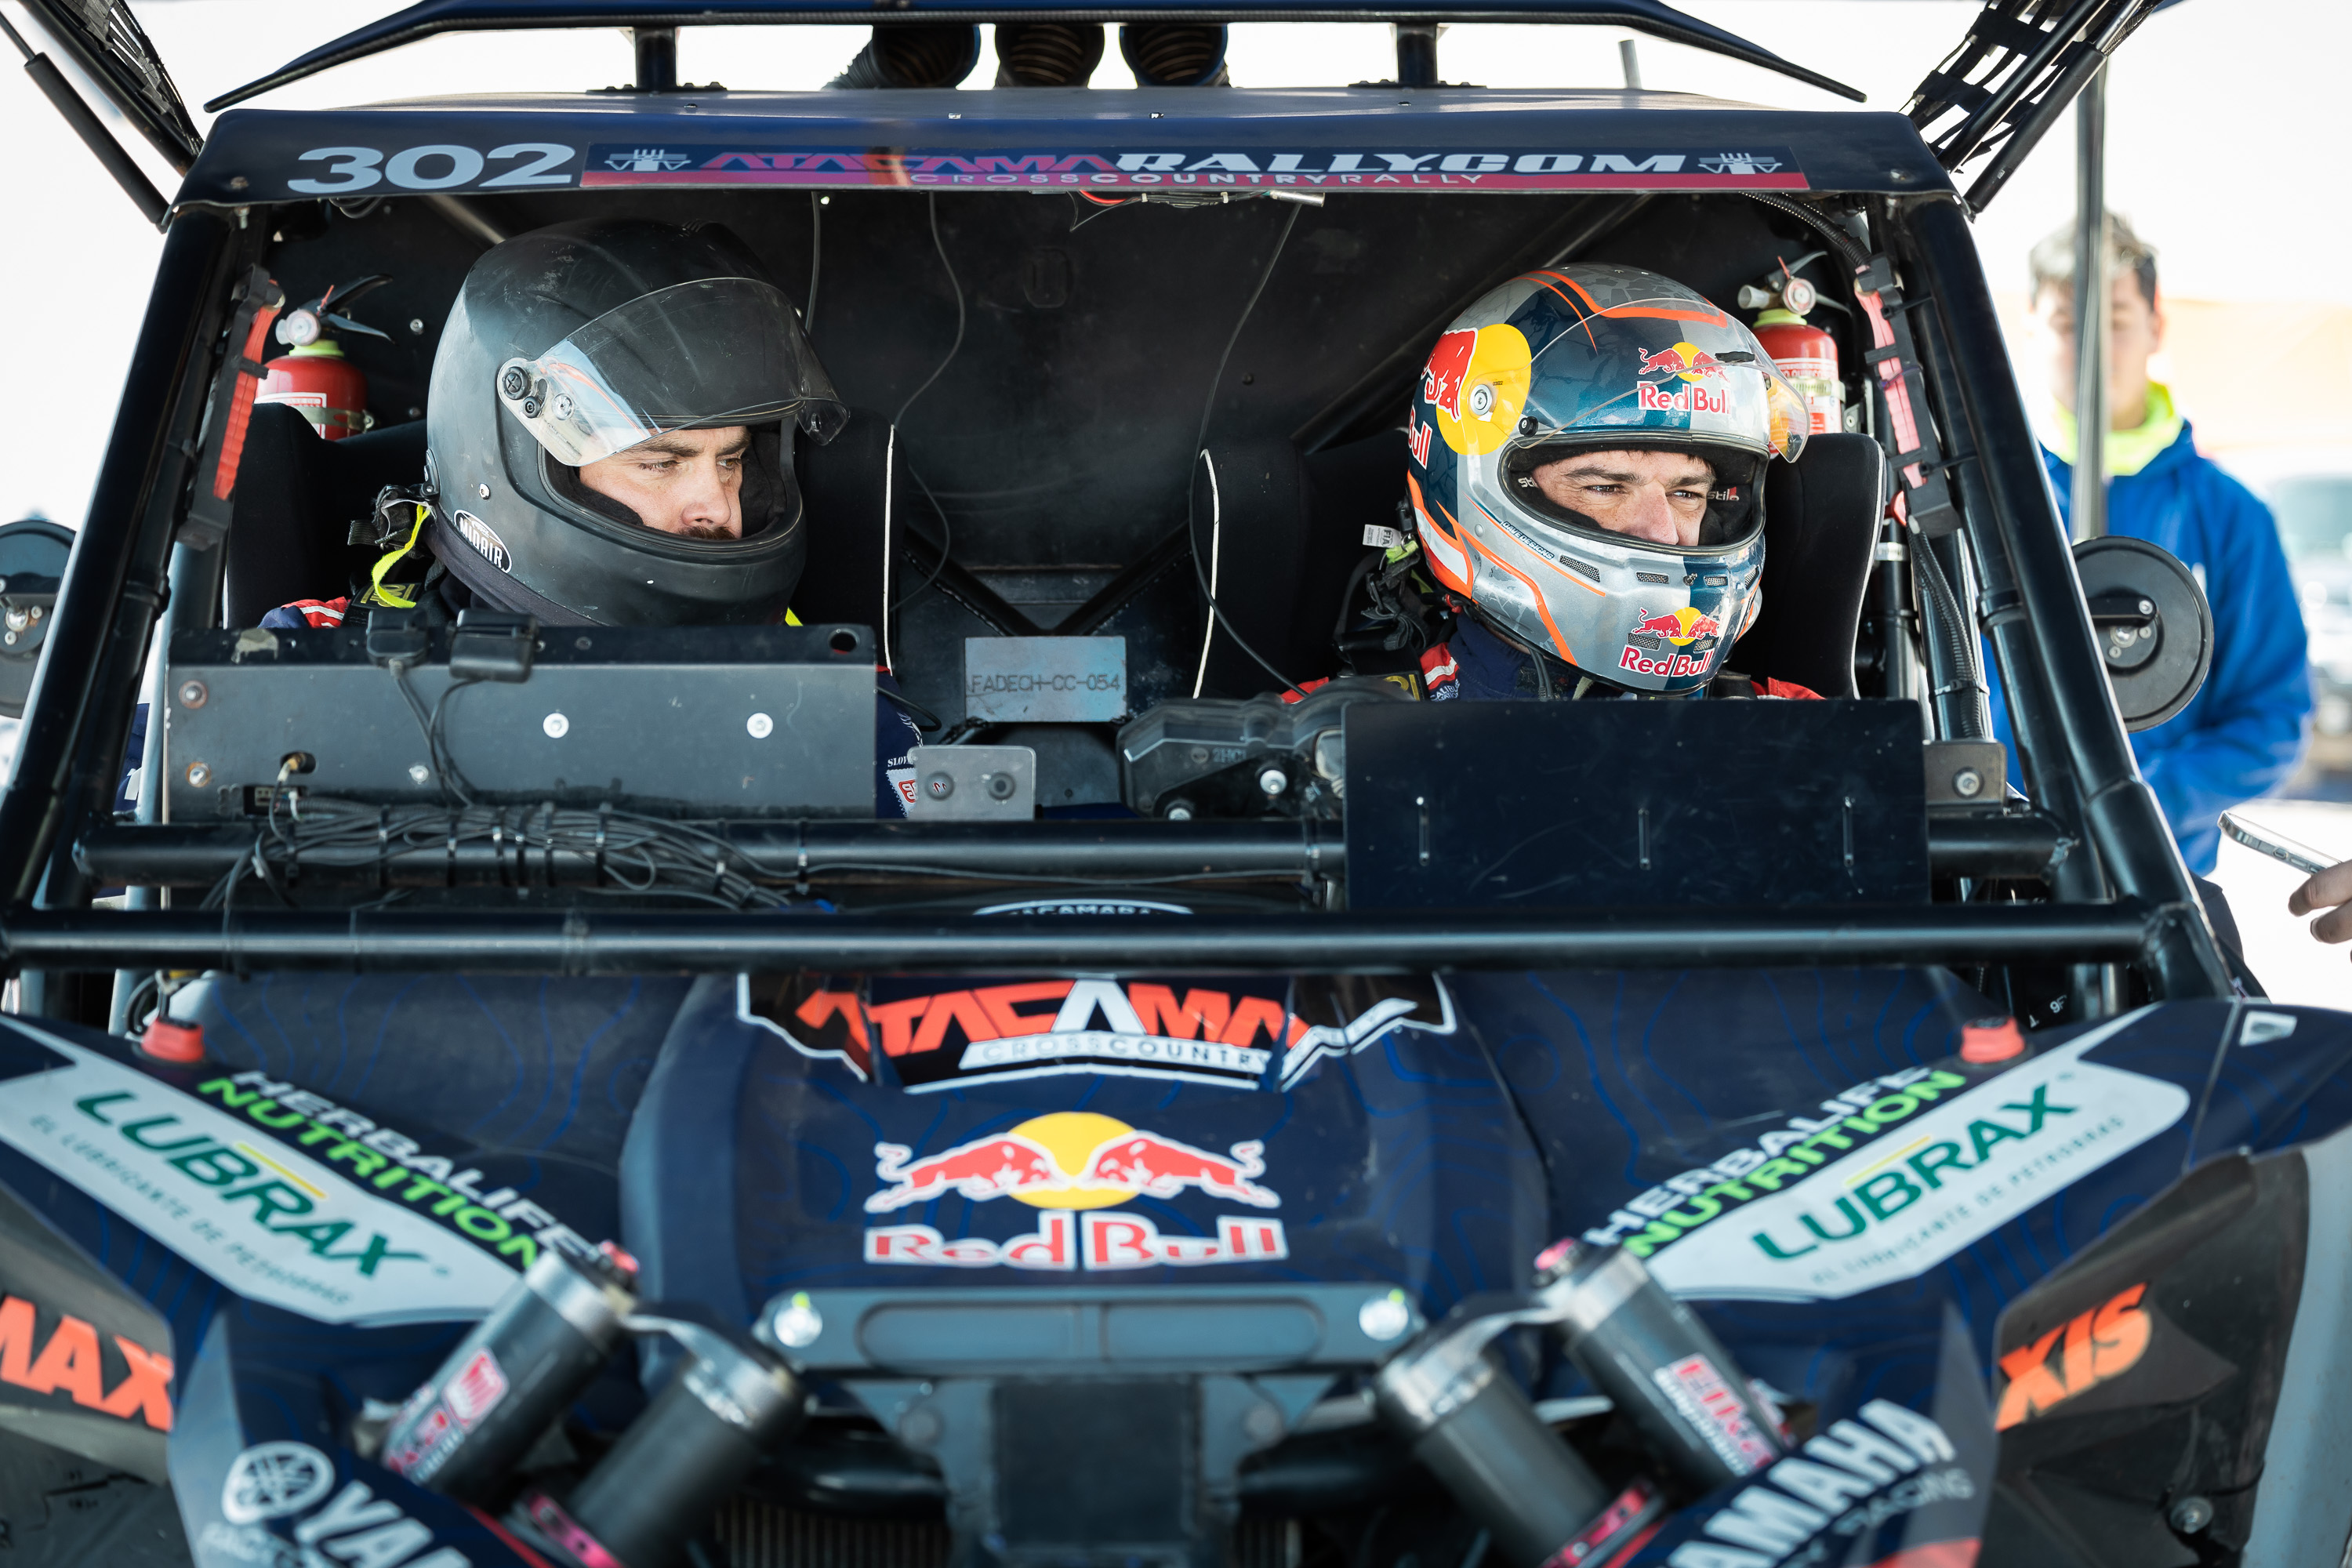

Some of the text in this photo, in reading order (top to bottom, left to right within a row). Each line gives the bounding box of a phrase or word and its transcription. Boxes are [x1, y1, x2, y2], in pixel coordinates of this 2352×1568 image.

[288, 143, 575, 194] 302
[1639, 381, 1731, 415] Red Bull
[459, 517, 503, 568] MIDAIR
[1382, 529, 1392, 545] FIA
[971, 674, 1120, 693] FADECH-CC-054
[1620, 646, 1715, 676] Red Bull
[795, 975, 1312, 1076] ATACAMA
[75, 1090, 430, 1278] LUBRAX
[198, 1078, 536, 1269] NUTRITION
[232, 1071, 605, 1260] HERBALIFE
[1581, 1066, 1932, 1247] HERBALIFE
[1622, 1069, 1966, 1258] NUTRITION
[1751, 1082, 2082, 1262] LUBRAX
[872, 1215, 1281, 1265] Red Bull
